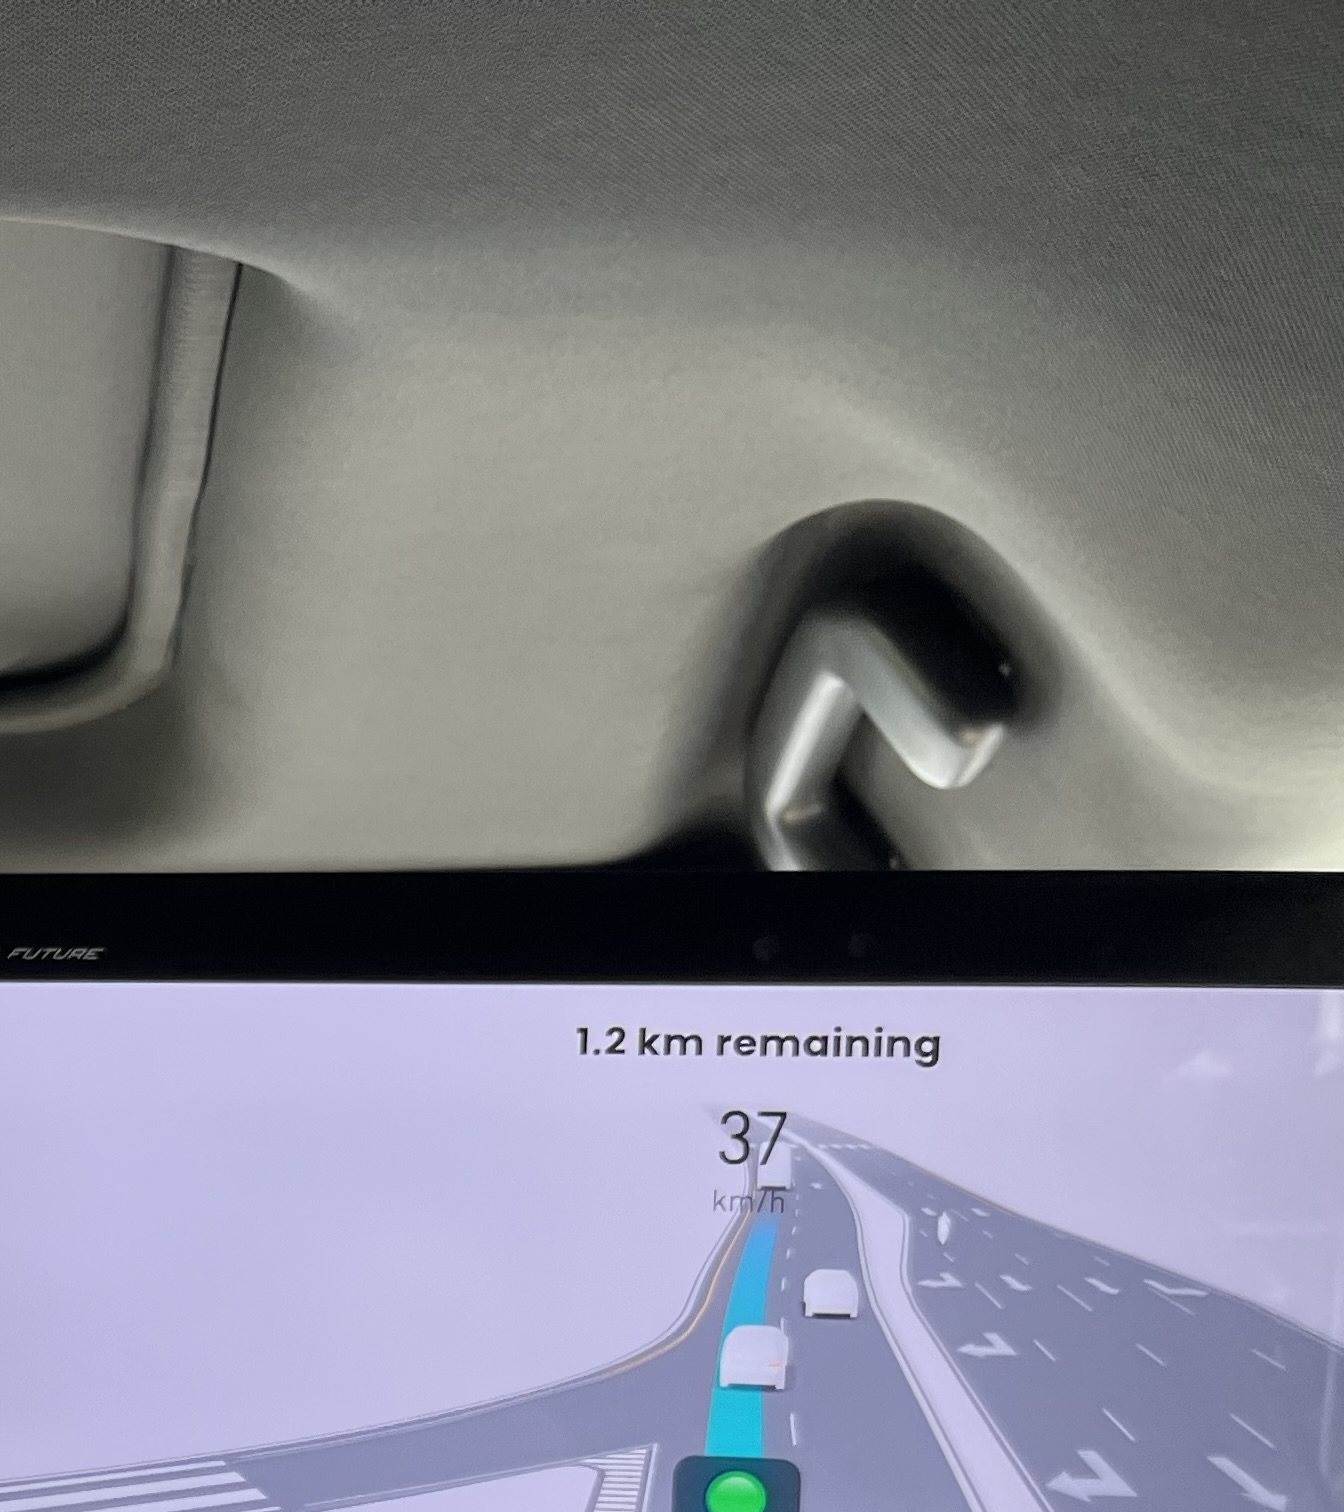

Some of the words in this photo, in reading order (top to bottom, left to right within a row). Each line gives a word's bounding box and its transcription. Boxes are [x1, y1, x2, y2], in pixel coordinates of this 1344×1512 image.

[7, 947, 105, 961] FUTURE
[577, 1026, 626, 1056] 1.2
[639, 1027, 703, 1056] km
[717, 1026, 941, 1068] remaining
[718, 1110, 787, 1166] 37
[712, 1188, 785, 1214] km/h
